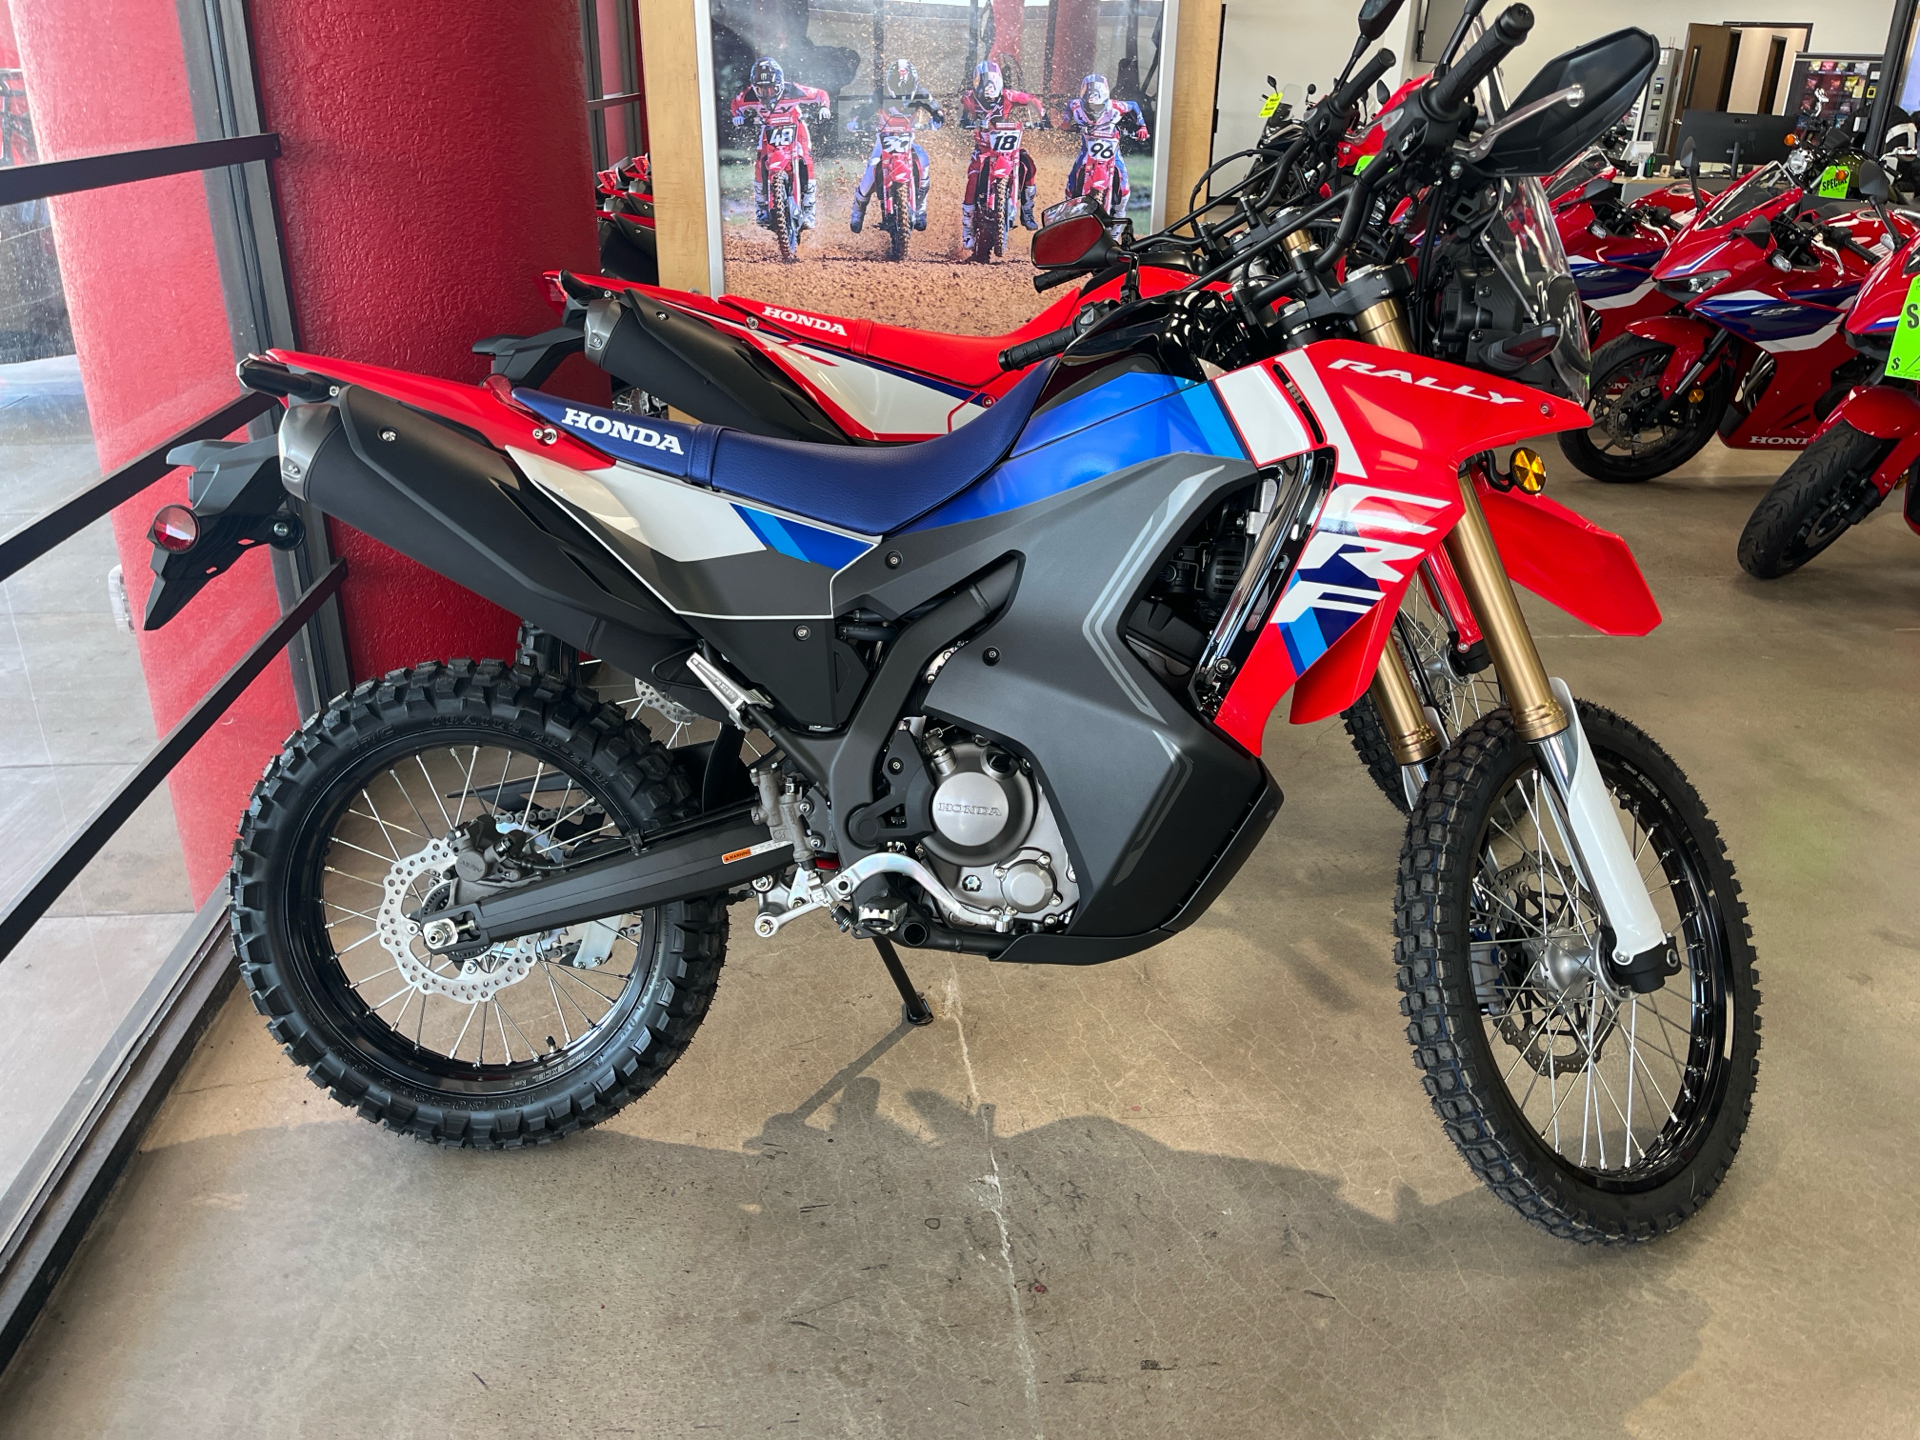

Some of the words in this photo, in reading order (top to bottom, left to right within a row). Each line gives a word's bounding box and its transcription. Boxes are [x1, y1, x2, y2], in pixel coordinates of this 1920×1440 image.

[769, 128, 794, 147] 48
[993, 134, 1018, 151] 18
[1090, 142, 1115, 159] 96
[761, 305, 847, 337] HONDA
[1327, 358, 1525, 405] RALLY
[561, 407, 685, 456] HONDA
[938, 801, 1003, 817] HONDA
